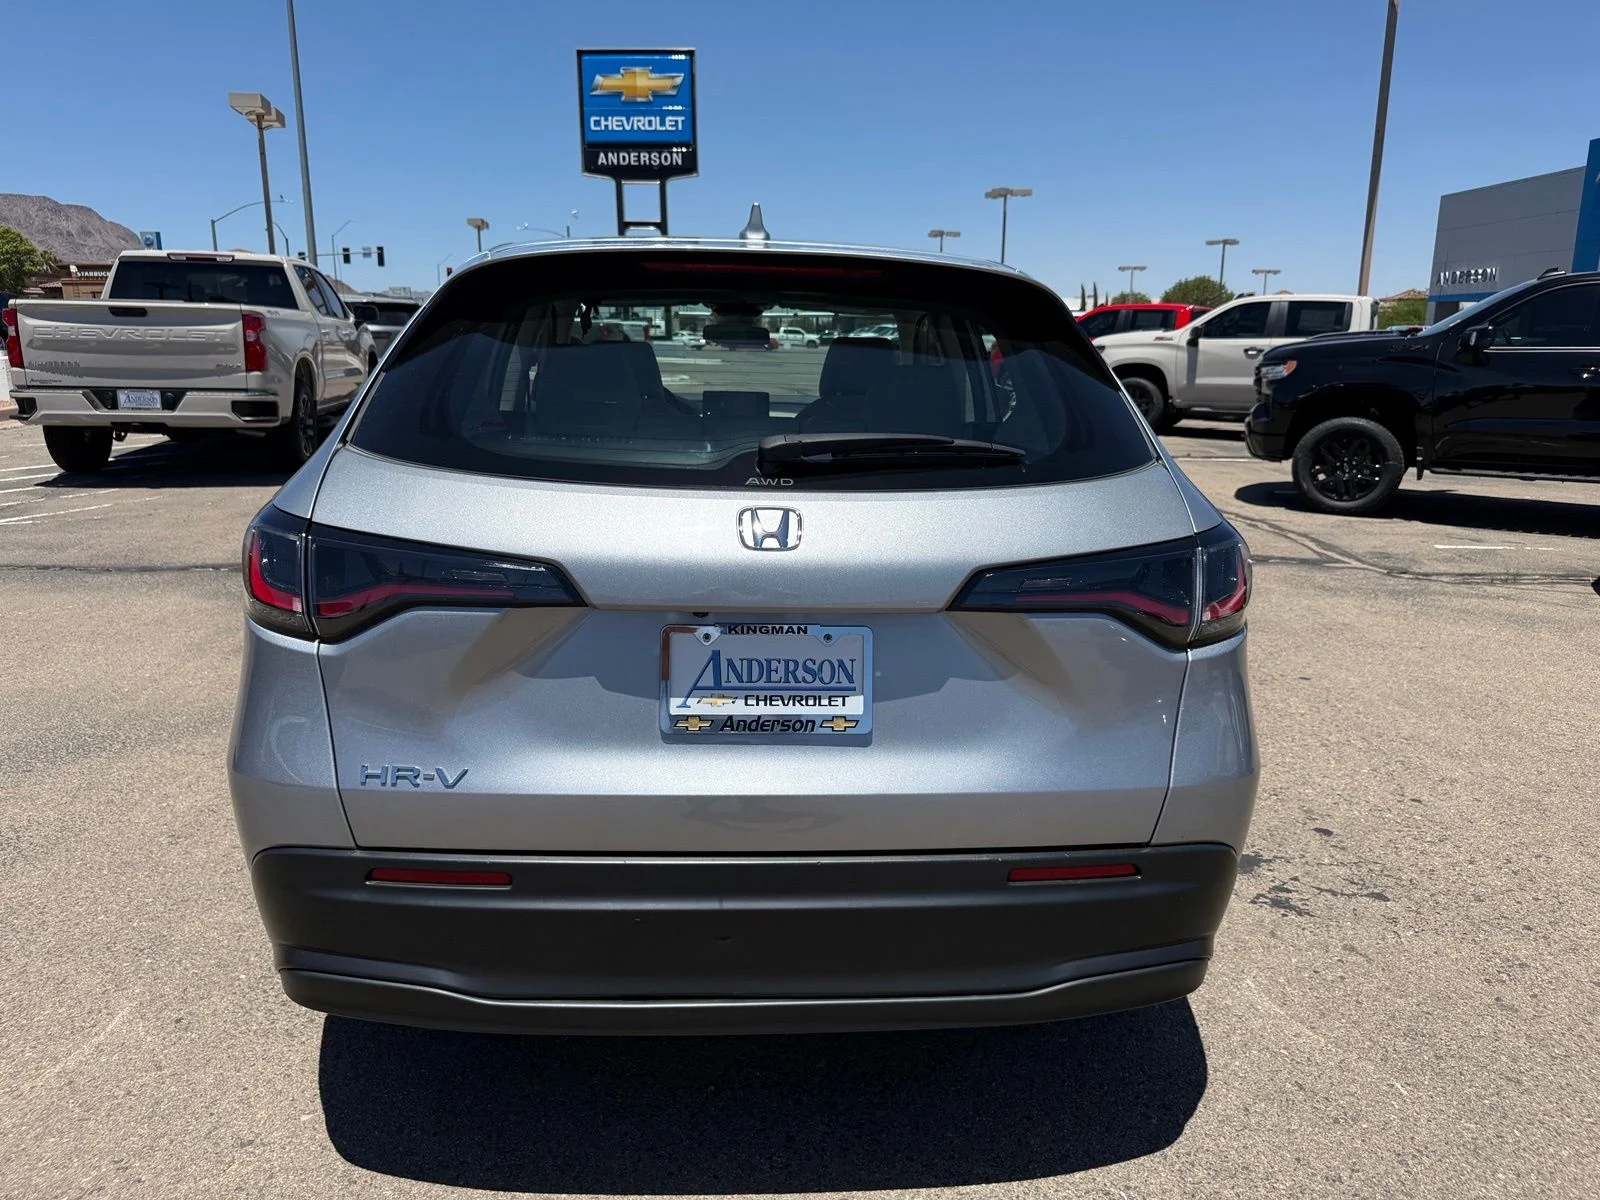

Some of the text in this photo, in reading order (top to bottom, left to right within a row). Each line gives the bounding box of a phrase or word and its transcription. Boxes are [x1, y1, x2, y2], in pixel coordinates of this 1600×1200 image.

[590, 116, 685, 131] CHEVROLET
[597, 152, 682, 166] ANDERSON
[1435, 267, 1497, 285] ANDERSON
[33, 326, 227, 342] CHEVROLET
[745, 477, 794, 486] AWD
[727, 625, 808, 635] KINGMAN
[676, 649, 856, 708] ANDERSON
[744, 694, 850, 707] CHEVROLET
[719, 715, 816, 733] Anderson
[360, 764, 469, 789] HR-V
